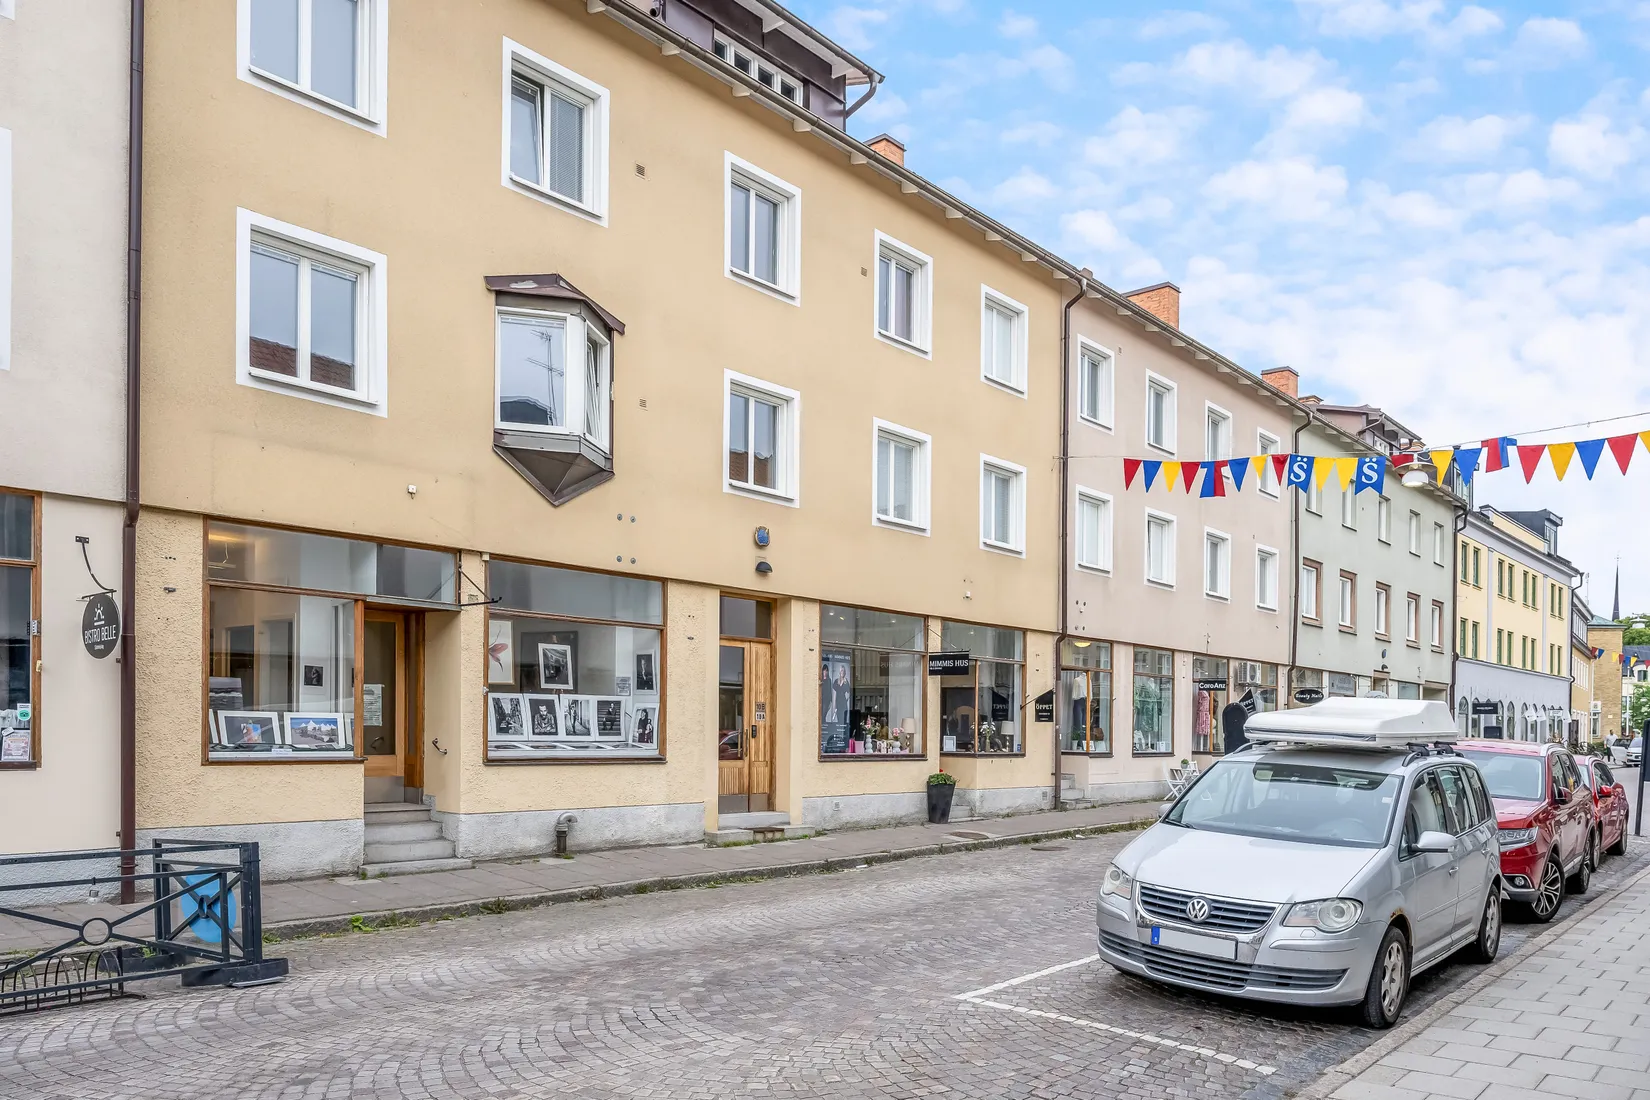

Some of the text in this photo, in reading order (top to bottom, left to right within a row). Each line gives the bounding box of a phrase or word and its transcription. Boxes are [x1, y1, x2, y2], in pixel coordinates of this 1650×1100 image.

[85, 625, 116, 644] BISTRO BELLE
[955, 659, 969, 667] HUS
